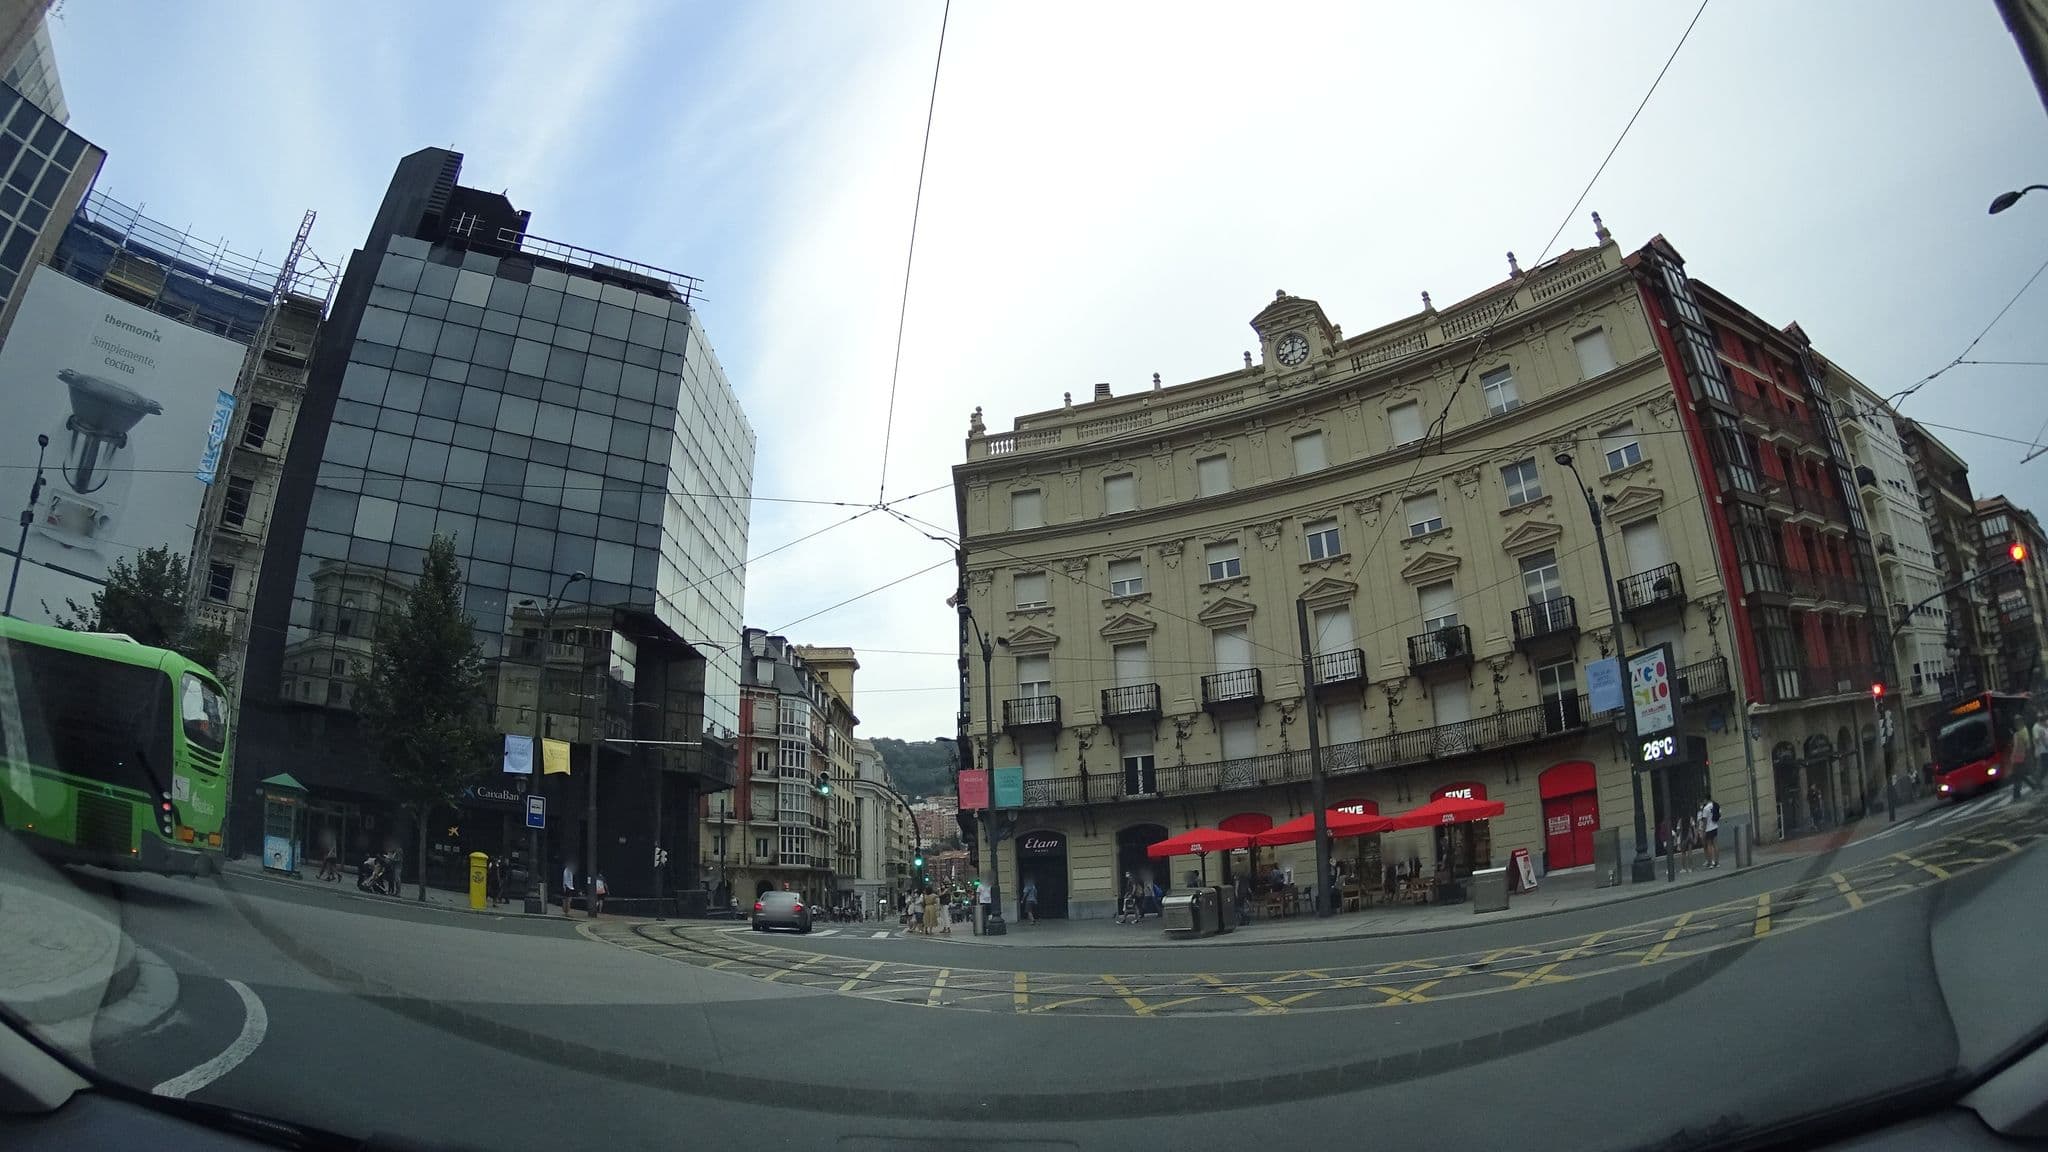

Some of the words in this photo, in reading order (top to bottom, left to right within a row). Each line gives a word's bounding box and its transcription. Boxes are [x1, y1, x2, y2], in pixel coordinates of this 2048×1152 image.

[104, 313, 162, 343] thermomix
[104, 357, 136, 375] cocina
[477, 786, 520, 801] CaixaBan
[1577, 819, 1594, 827] GUYS
[1025, 838, 1058, 849] Etam
